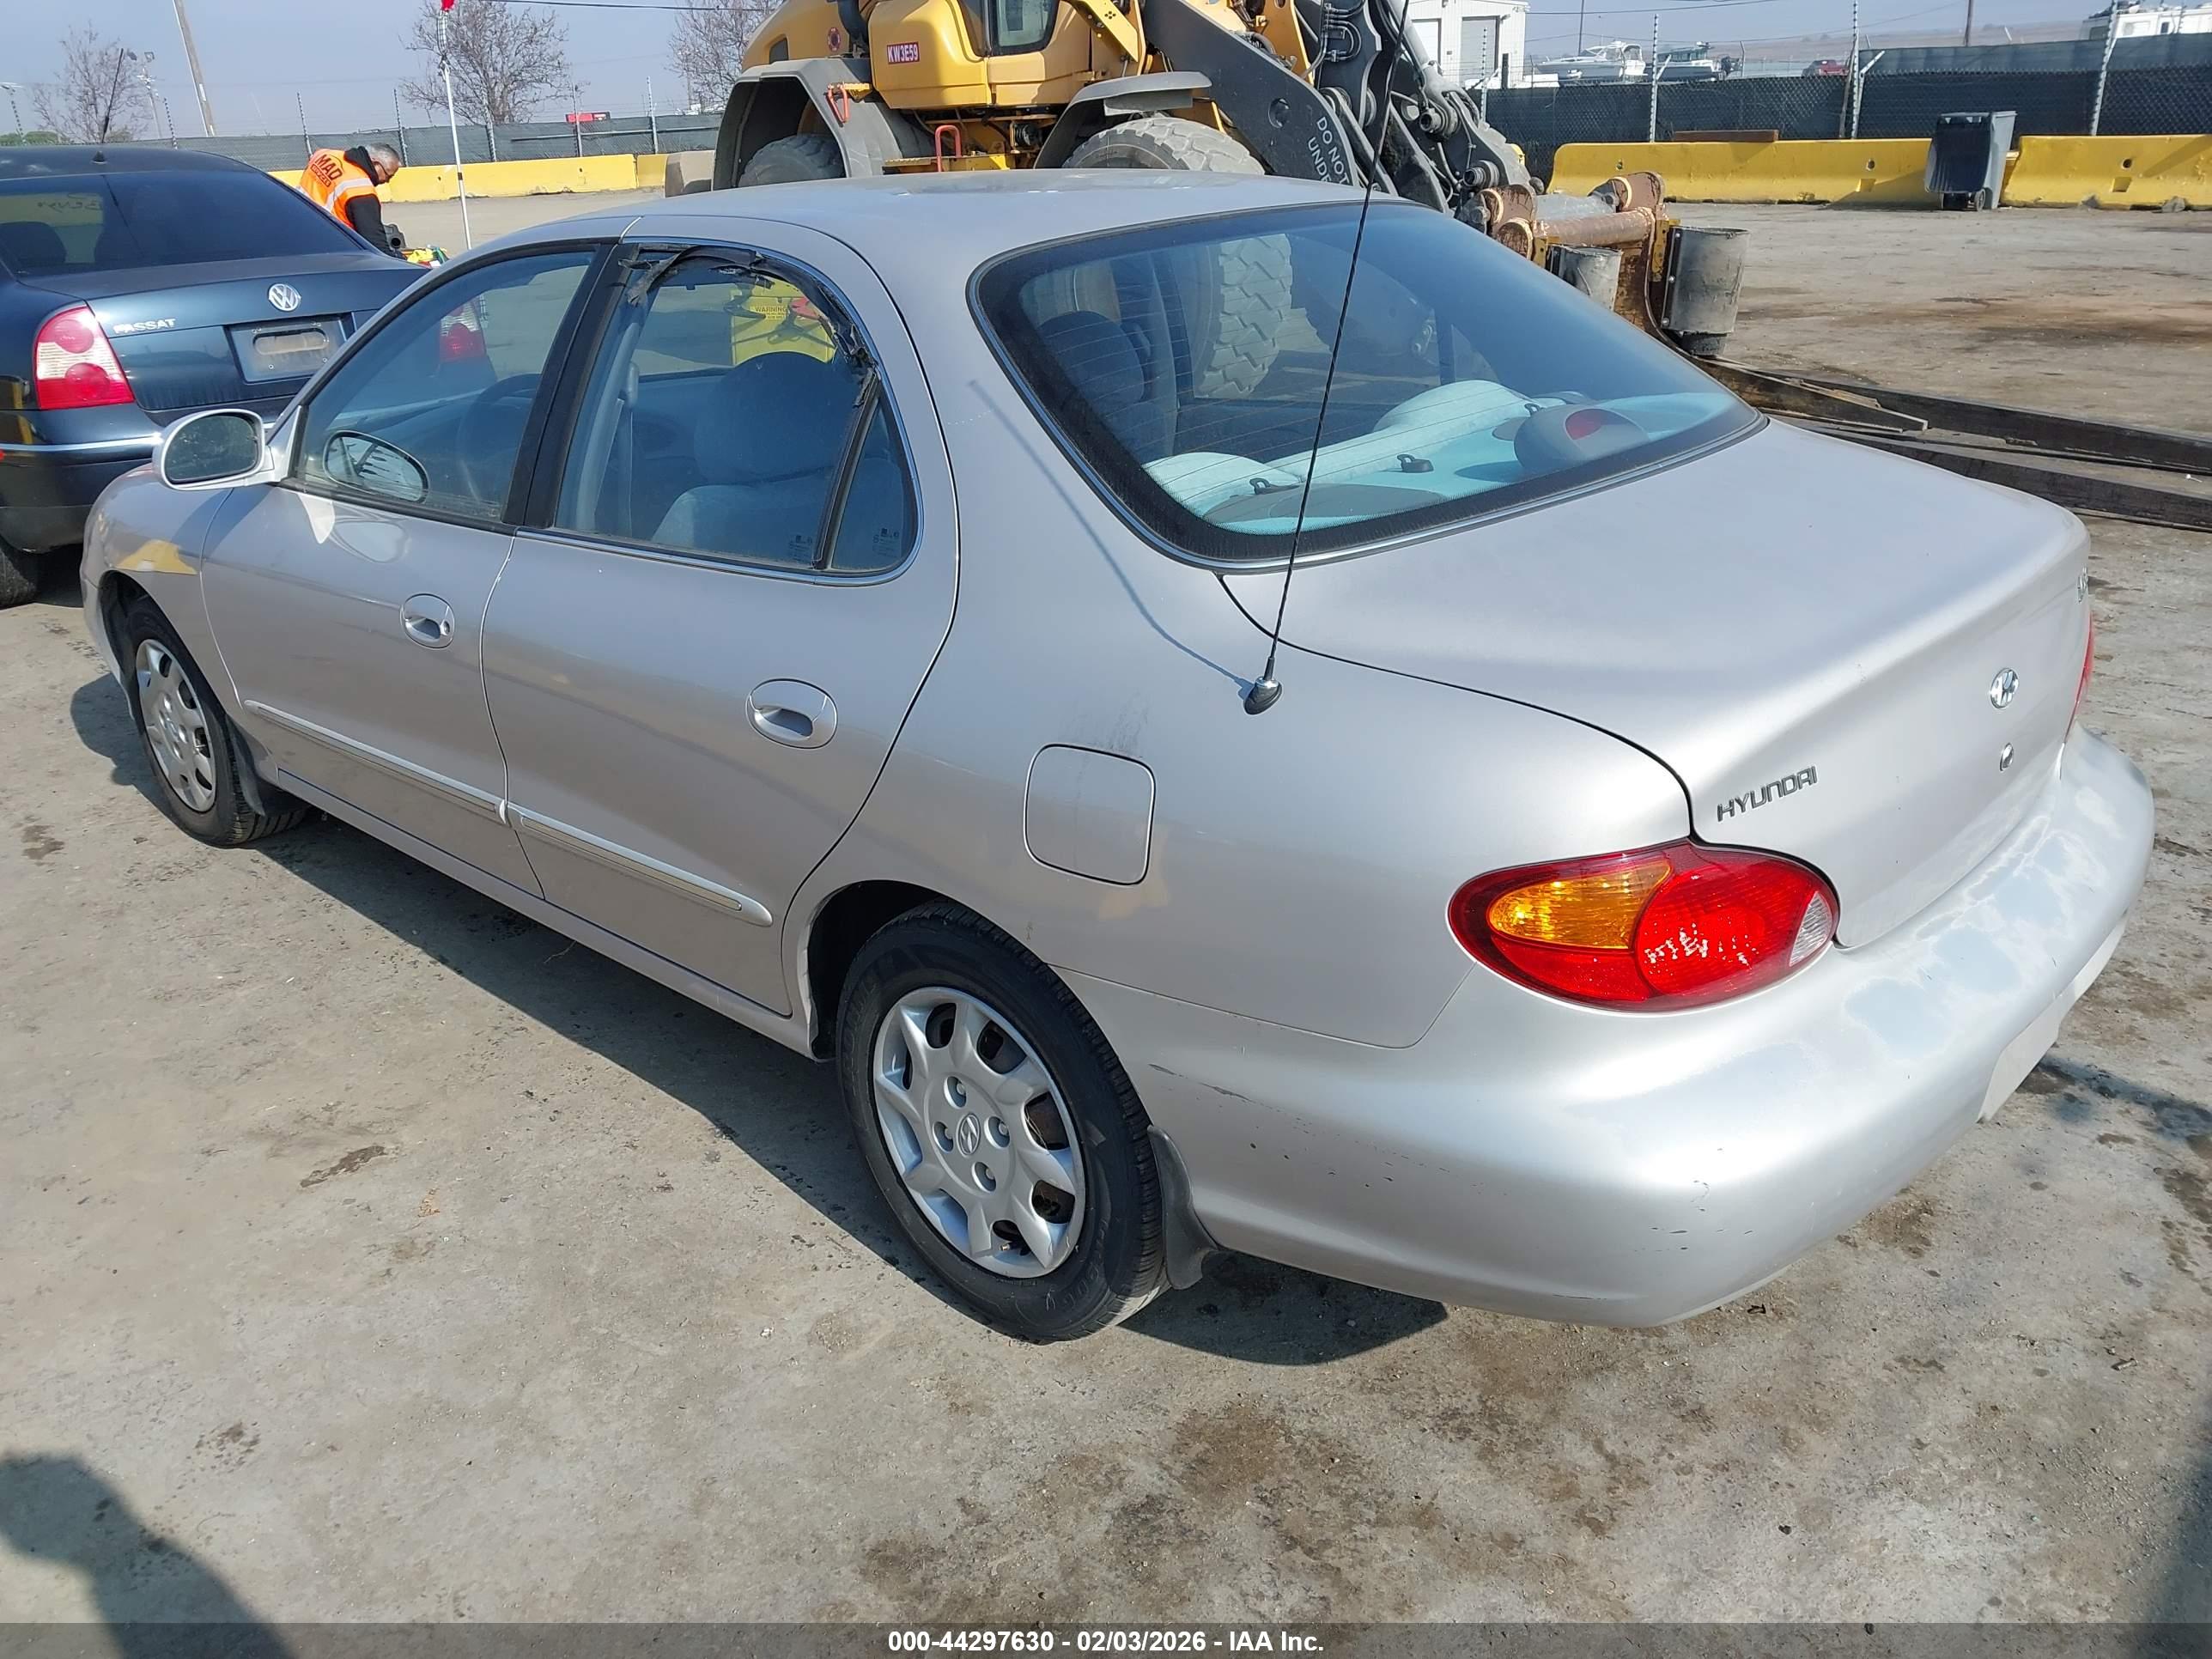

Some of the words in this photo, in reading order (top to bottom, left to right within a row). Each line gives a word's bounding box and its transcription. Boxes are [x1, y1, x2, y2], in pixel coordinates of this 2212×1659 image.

[888, 43, 919, 63] KW3E59
[1316, 116, 1333, 144] DO
[1328, 146, 1349, 185] NOT
[314, 154, 343, 180] MAD
[112, 318, 176, 334] PASSAT
[1717, 766, 1818, 822] HYUNDAI
